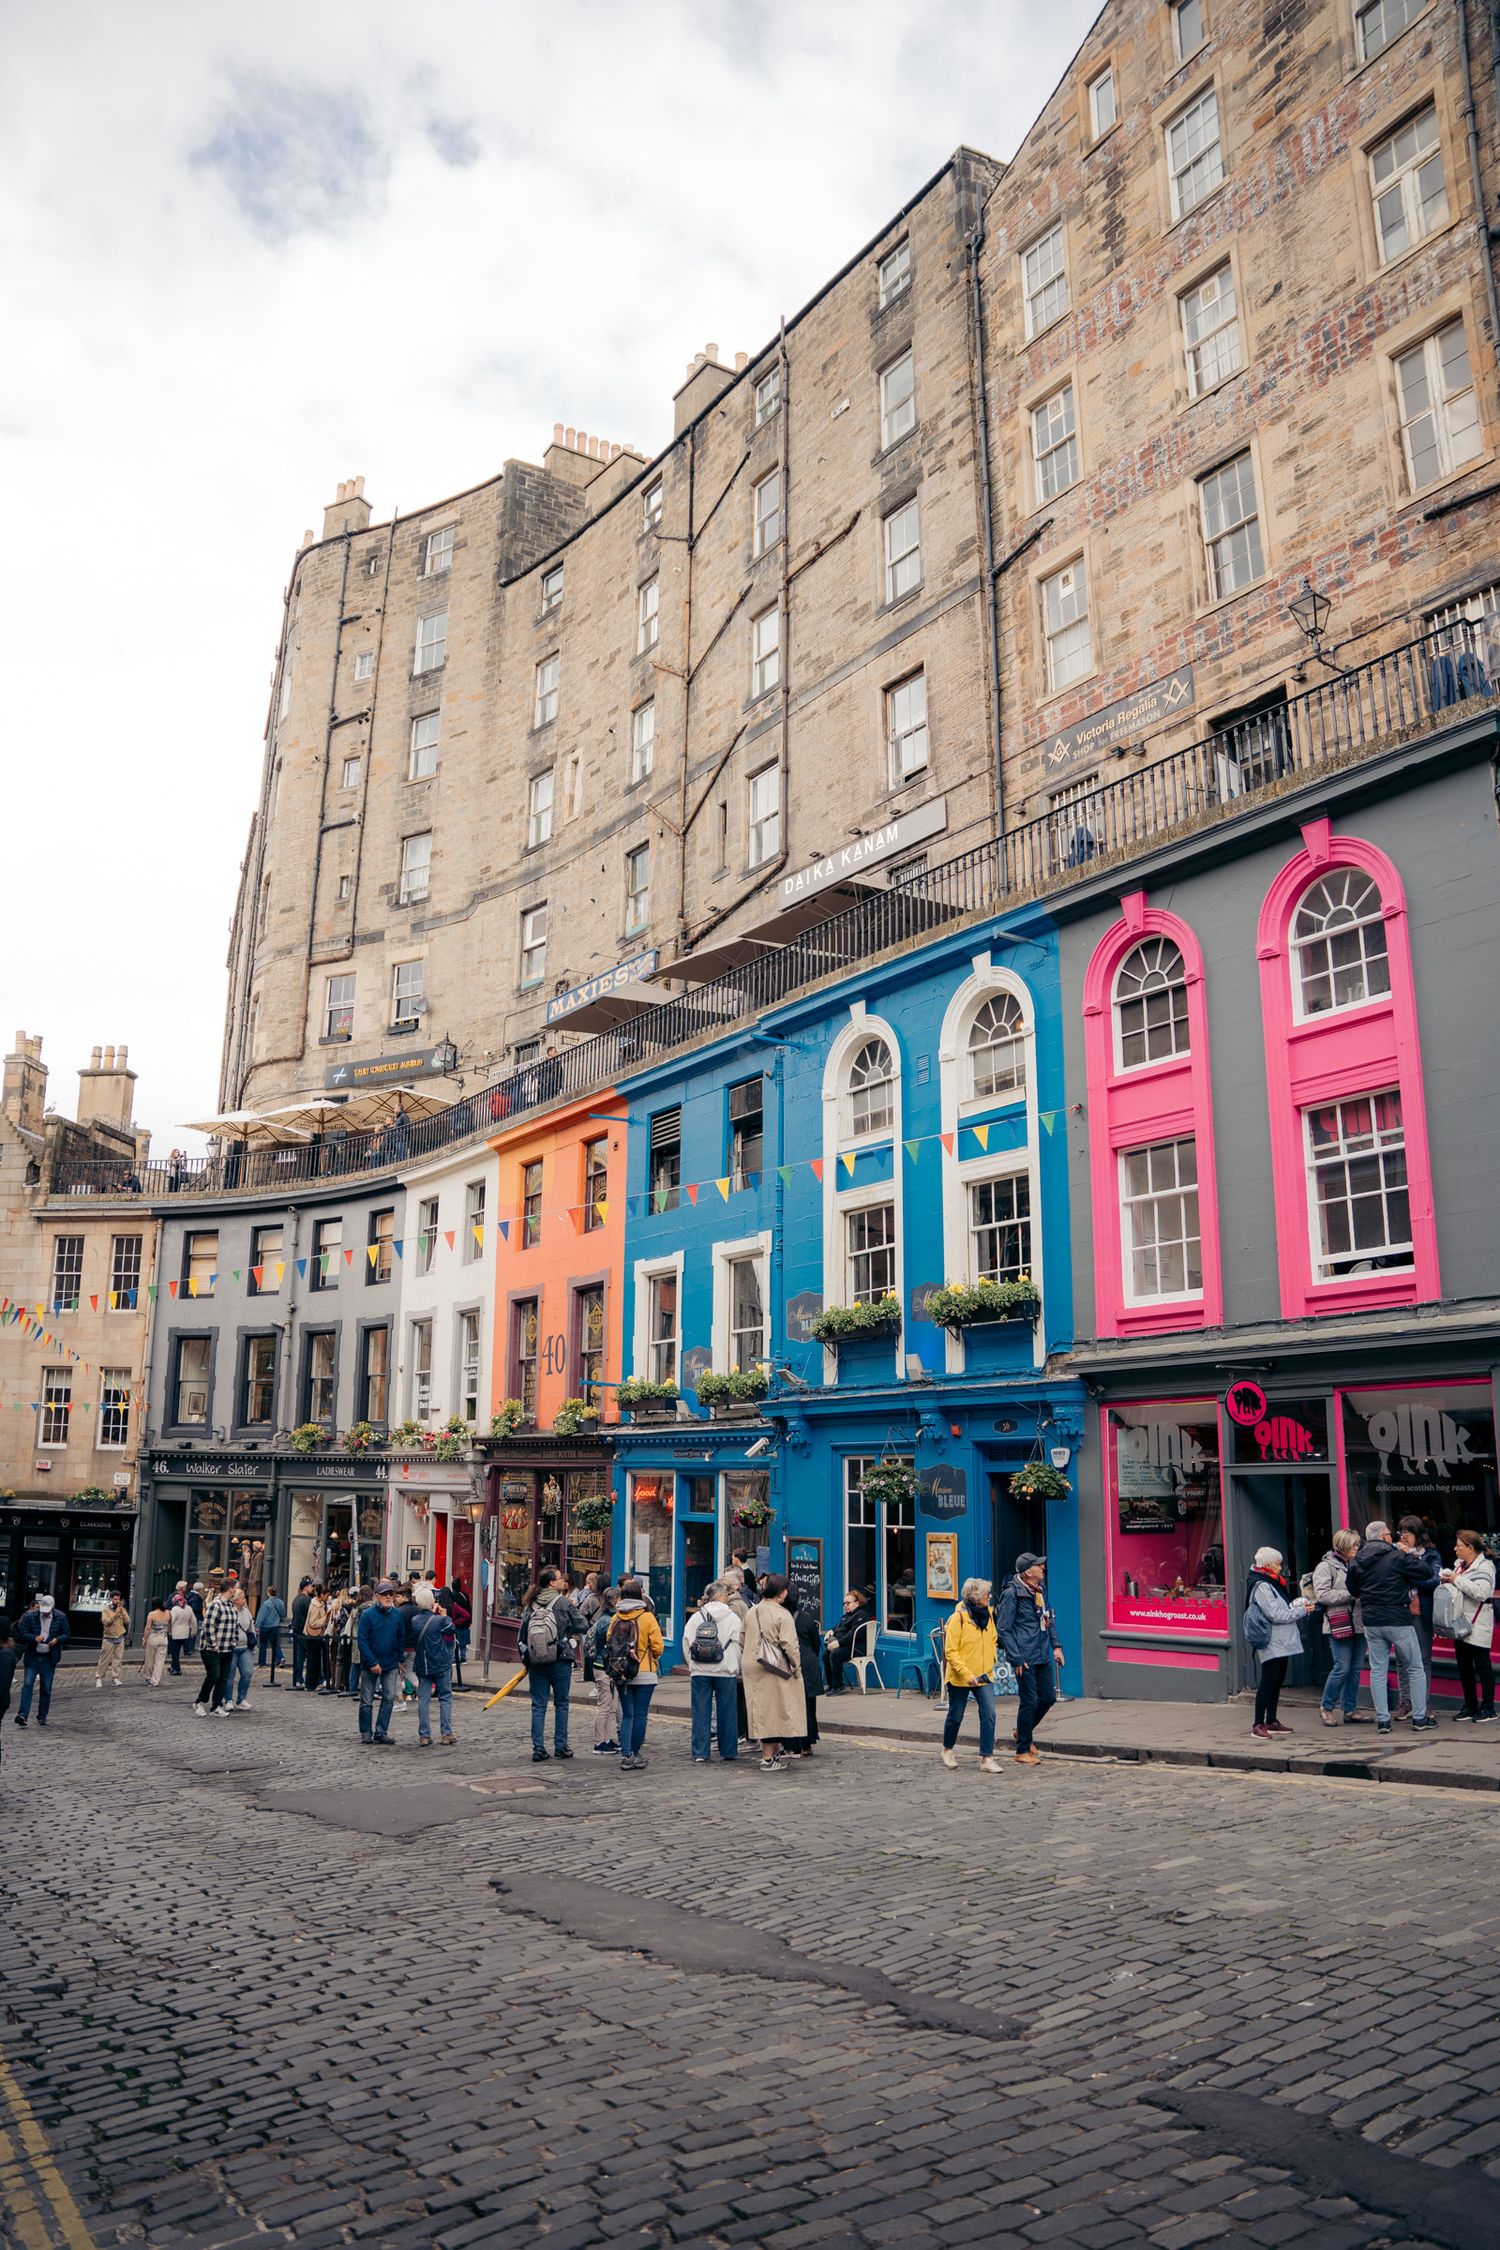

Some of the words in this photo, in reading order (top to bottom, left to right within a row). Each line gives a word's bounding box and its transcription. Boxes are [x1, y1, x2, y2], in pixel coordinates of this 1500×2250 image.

[1076, 718, 1115, 745] Victoria
[1117, 696, 1158, 725] Regalia
[1073, 741, 1095, 759] SHOP
[784, 858, 835, 895] DAIKA
[841, 823, 899, 867] KANAM
[549, 966, 629, 1019] MAXIES
[541, 1333, 566, 1376] 40
[152, 1460, 170, 1474] 46.
[186, 1461, 222, 1474] Walker
[228, 1461, 260, 1475] Slater
[316, 1465, 356, 1477] LADIESWEAR
[633, 1485, 658, 1502] food
[1376, 1484, 1405, 1492] delicious
[1407, 1484, 1435, 1492] scottish
[1436, 1484, 1450, 1493] hog
[1452, 1484, 1475, 1492] roasts
[938, 1495, 966, 1508] BLEUE
[1129, 1609, 1207, 1620] www.oinkhogroast.co.uk
